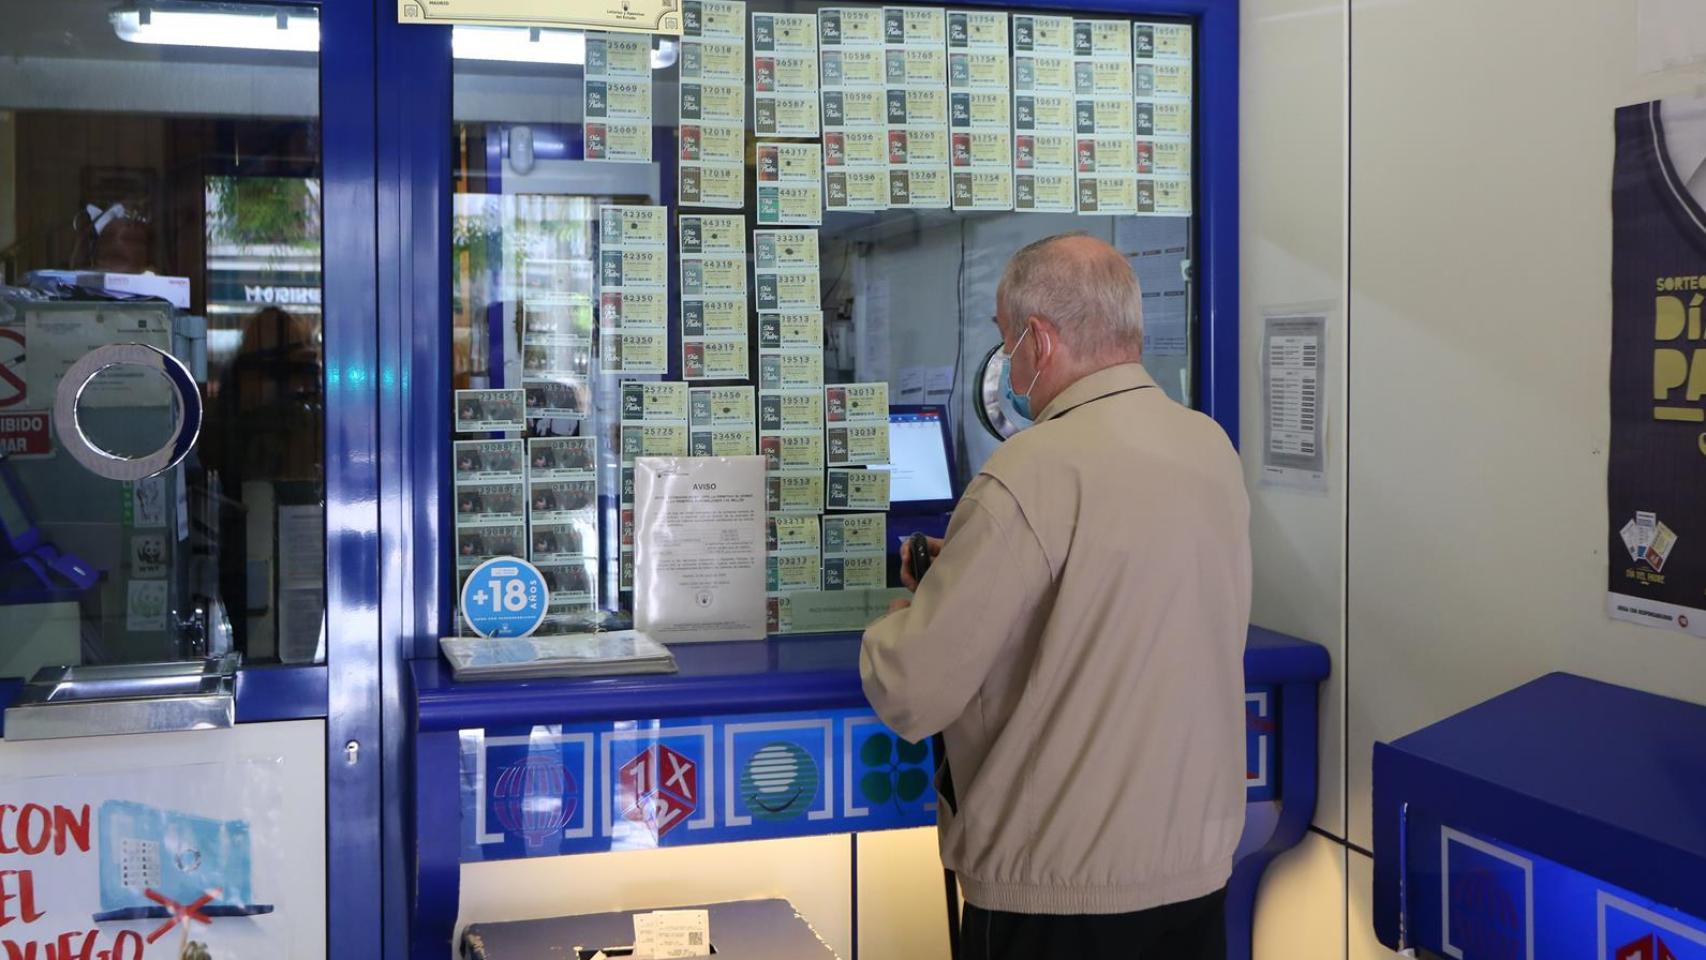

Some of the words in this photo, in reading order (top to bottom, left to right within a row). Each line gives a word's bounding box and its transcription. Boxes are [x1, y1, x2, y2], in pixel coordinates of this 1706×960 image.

[703, 4, 732, 12] 17018
[703, 44, 732, 53] 17018
[844, 52, 871, 60] 10596
[906, 52, 934, 60] 15765
[703, 86, 732, 94] 17018
[908, 92, 934, 100] 15765
[702, 170, 731, 178] 17018
[910, 172, 937, 180] 15765
[780, 188, 808, 197] 44317
[845, 558, 873, 567] 00147
[473, 579, 528, 612] +18
[528, 580, 537, 610] AÑOS
[665, 752, 692, 799] X
[0, 803, 90, 856] CON
